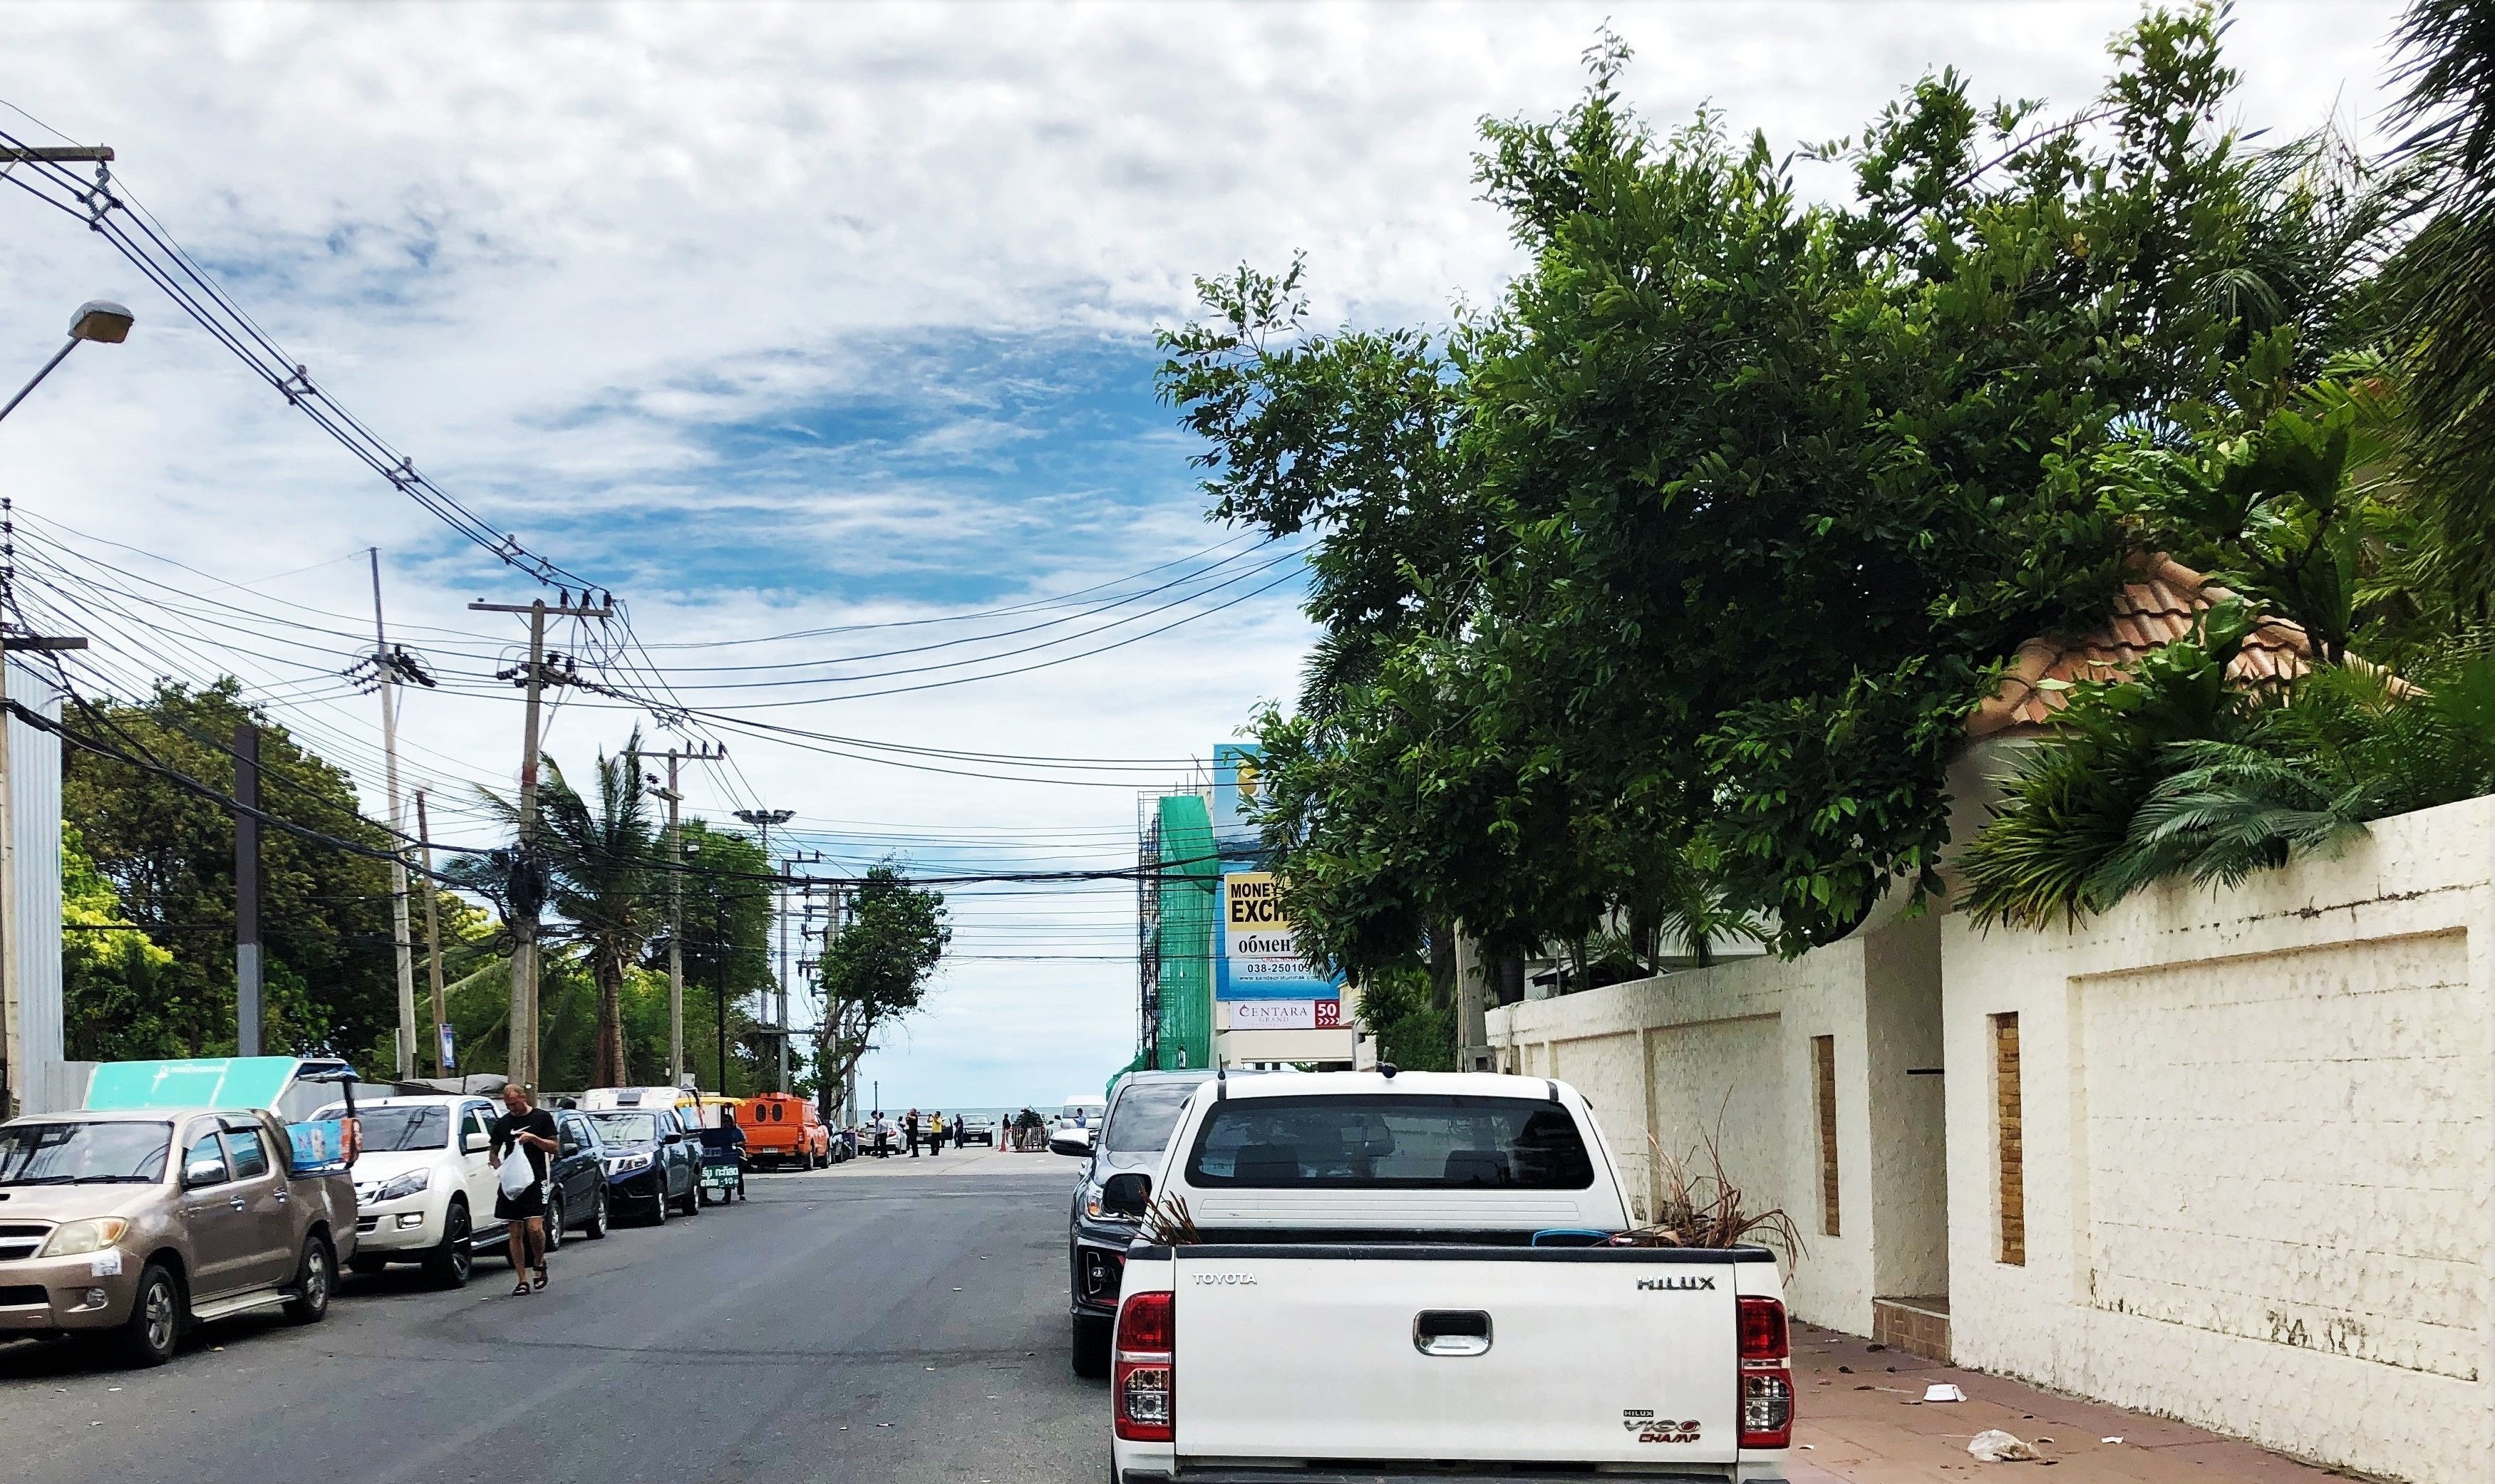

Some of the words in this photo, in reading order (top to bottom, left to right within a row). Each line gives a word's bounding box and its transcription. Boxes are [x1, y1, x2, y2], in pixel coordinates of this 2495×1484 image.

[1230, 883, 1279, 898] MONEY
[1231, 899, 1291, 923] EXCH
[1239, 935, 1291, 953] обмен
[1247, 963, 1311, 973] 038-250109
[1239, 1004, 1308, 1017] CENTARA
[1317, 1003, 1337, 1017] 50
[1192, 1272, 1258, 1285] TOYOTA
[1636, 1275, 1716, 1290] HILUX
[1638, 1433, 1701, 1443] CHAMP
